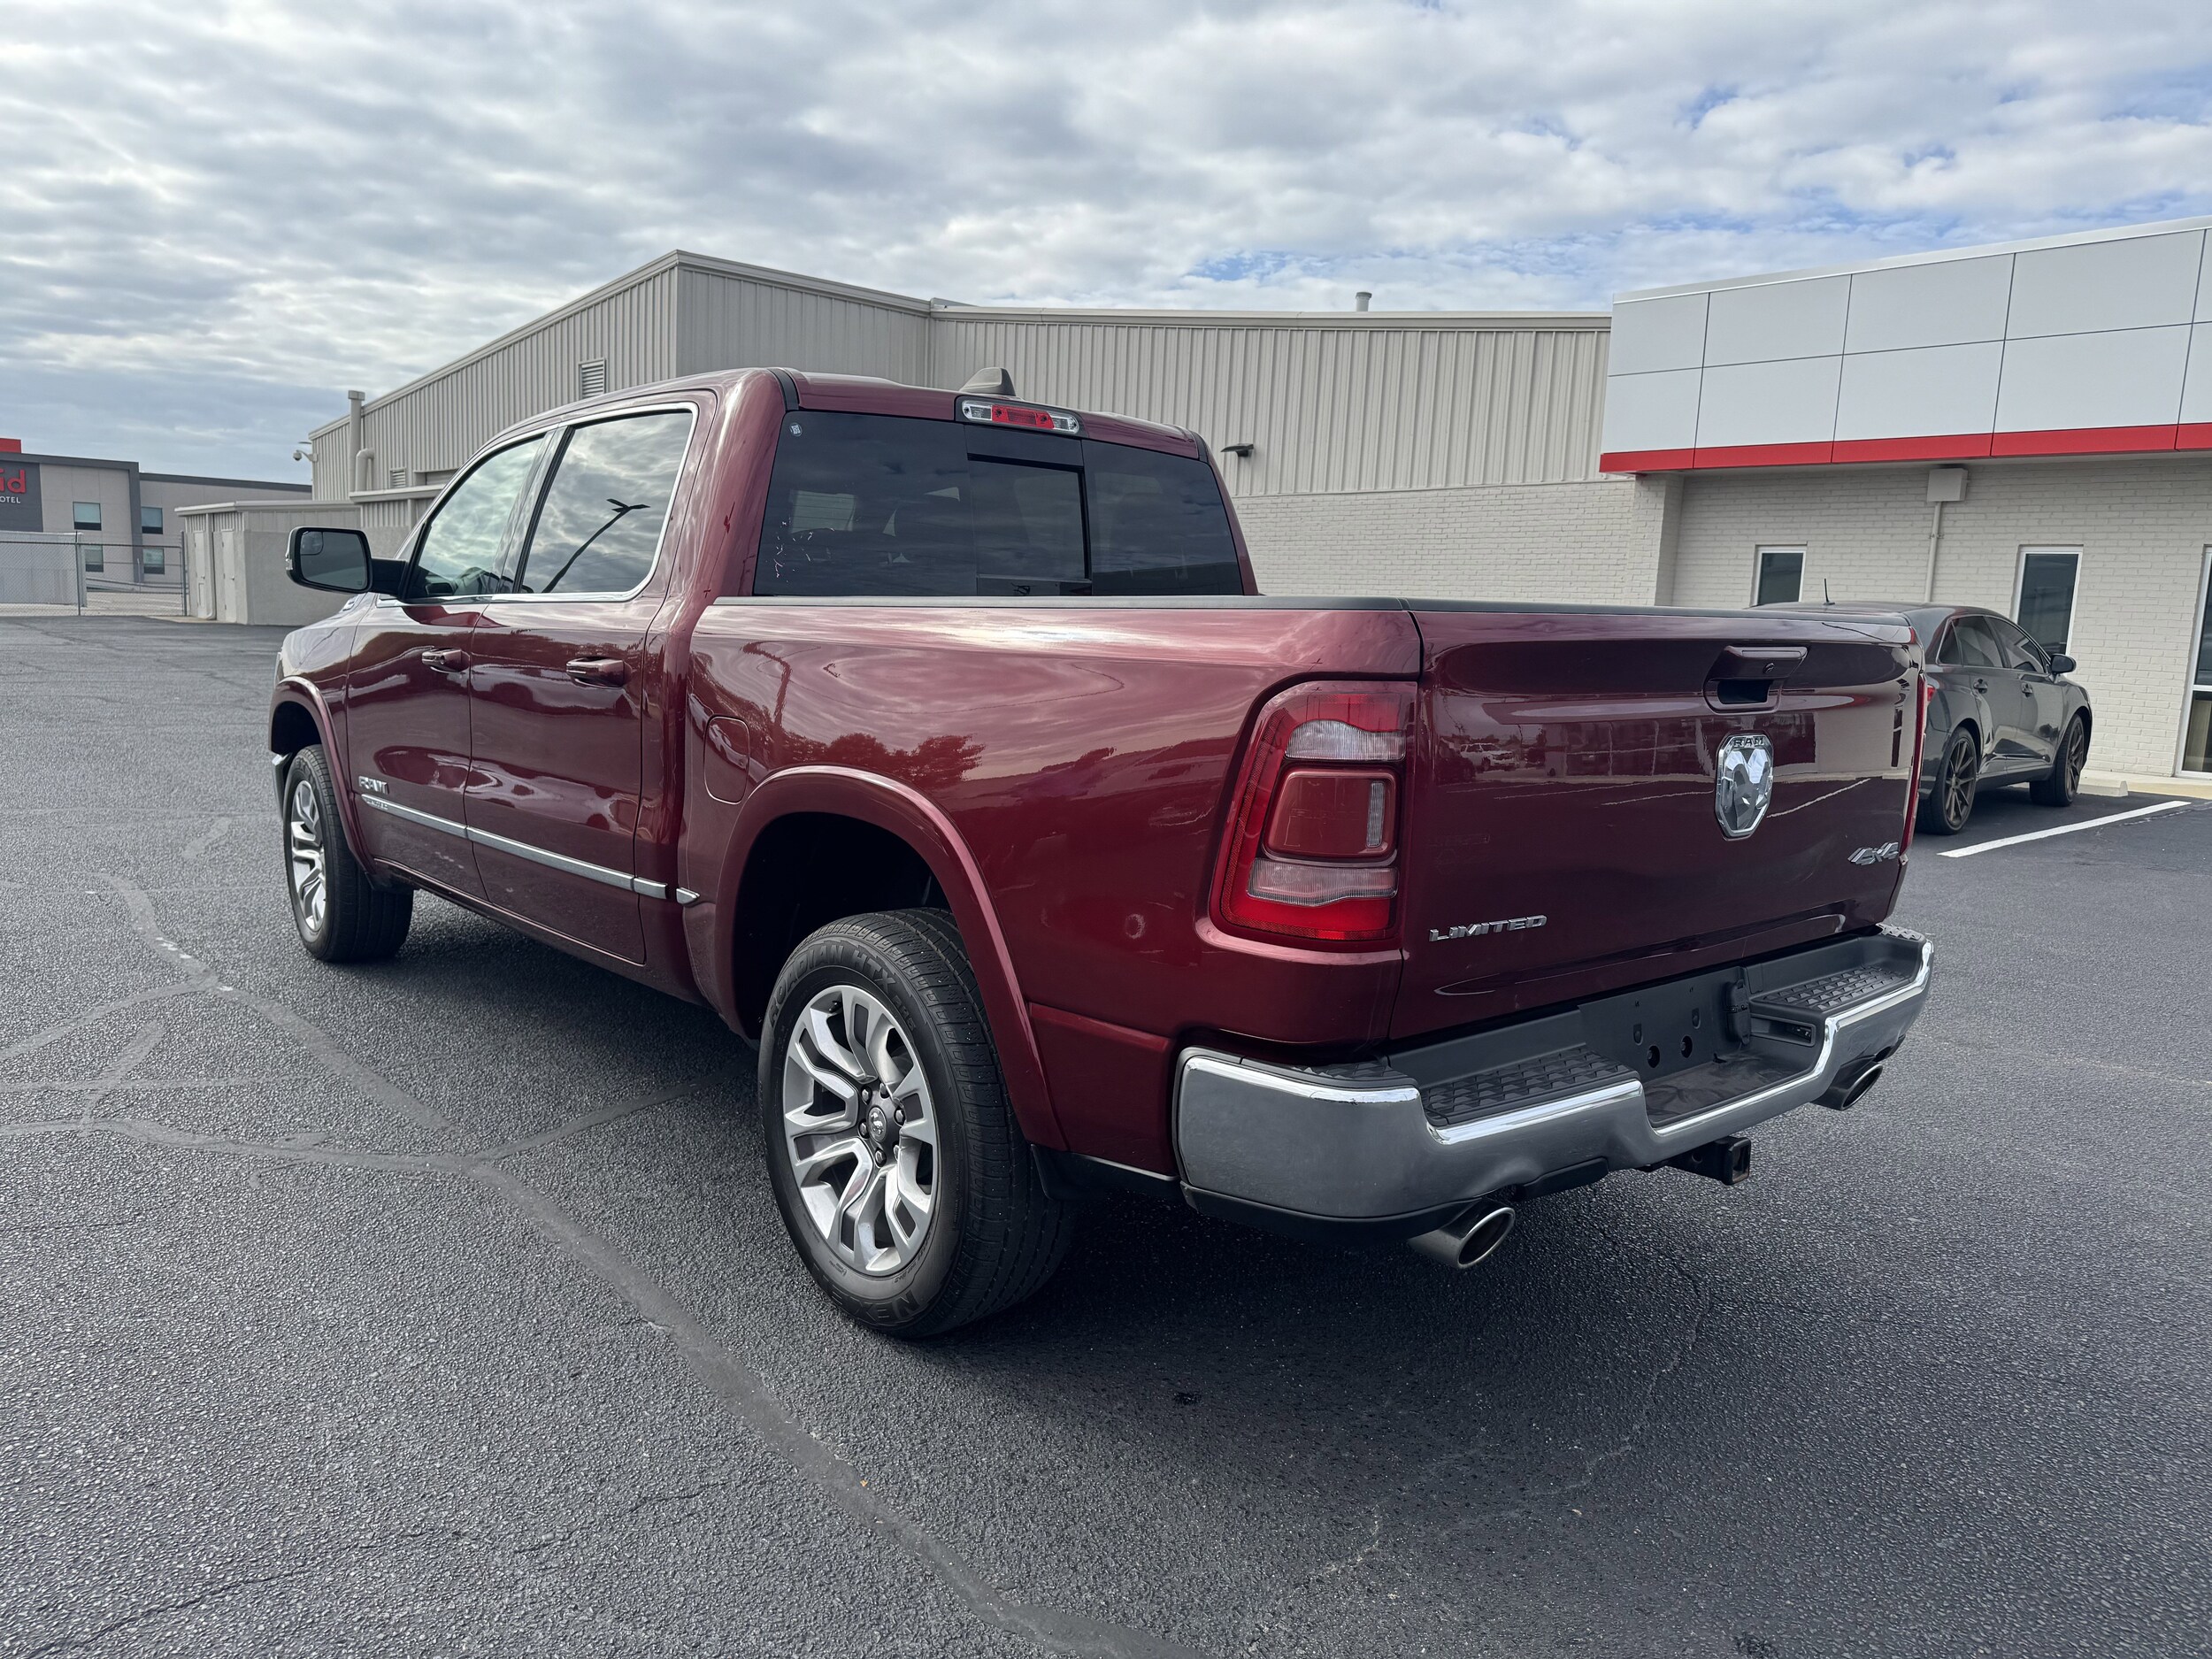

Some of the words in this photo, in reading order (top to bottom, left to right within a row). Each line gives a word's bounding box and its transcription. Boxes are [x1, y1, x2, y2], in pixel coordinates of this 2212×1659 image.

[1734, 737, 1765, 749] RAM
[357, 775, 390, 795] RAM
[1428, 914, 1548, 942] LIMITED
[768, 944, 845, 1027] ROADIAN
[852, 949, 896, 995] HTX
